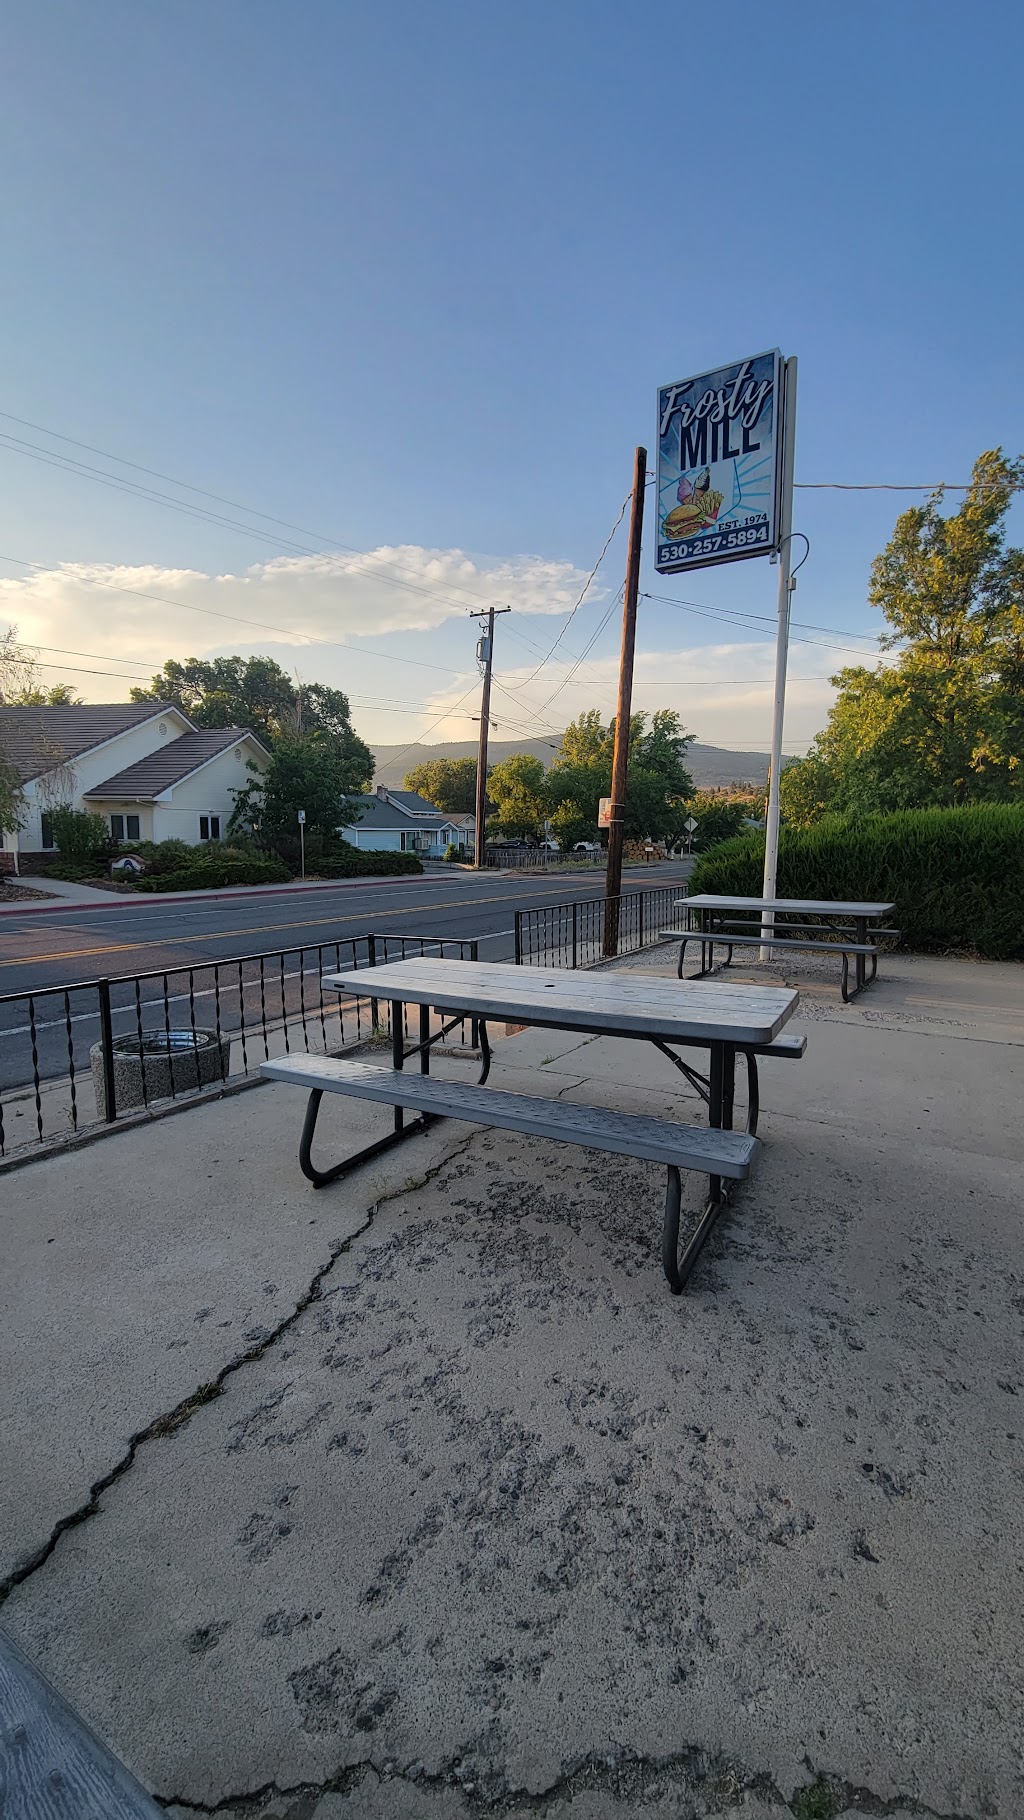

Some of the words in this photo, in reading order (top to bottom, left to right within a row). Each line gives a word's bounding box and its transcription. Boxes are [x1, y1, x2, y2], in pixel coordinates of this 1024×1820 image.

[660, 361, 774, 437] Frosty
[680, 409, 760, 471] MILL
[718, 519, 742, 532] EST.
[744, 512, 768, 526] 1974
